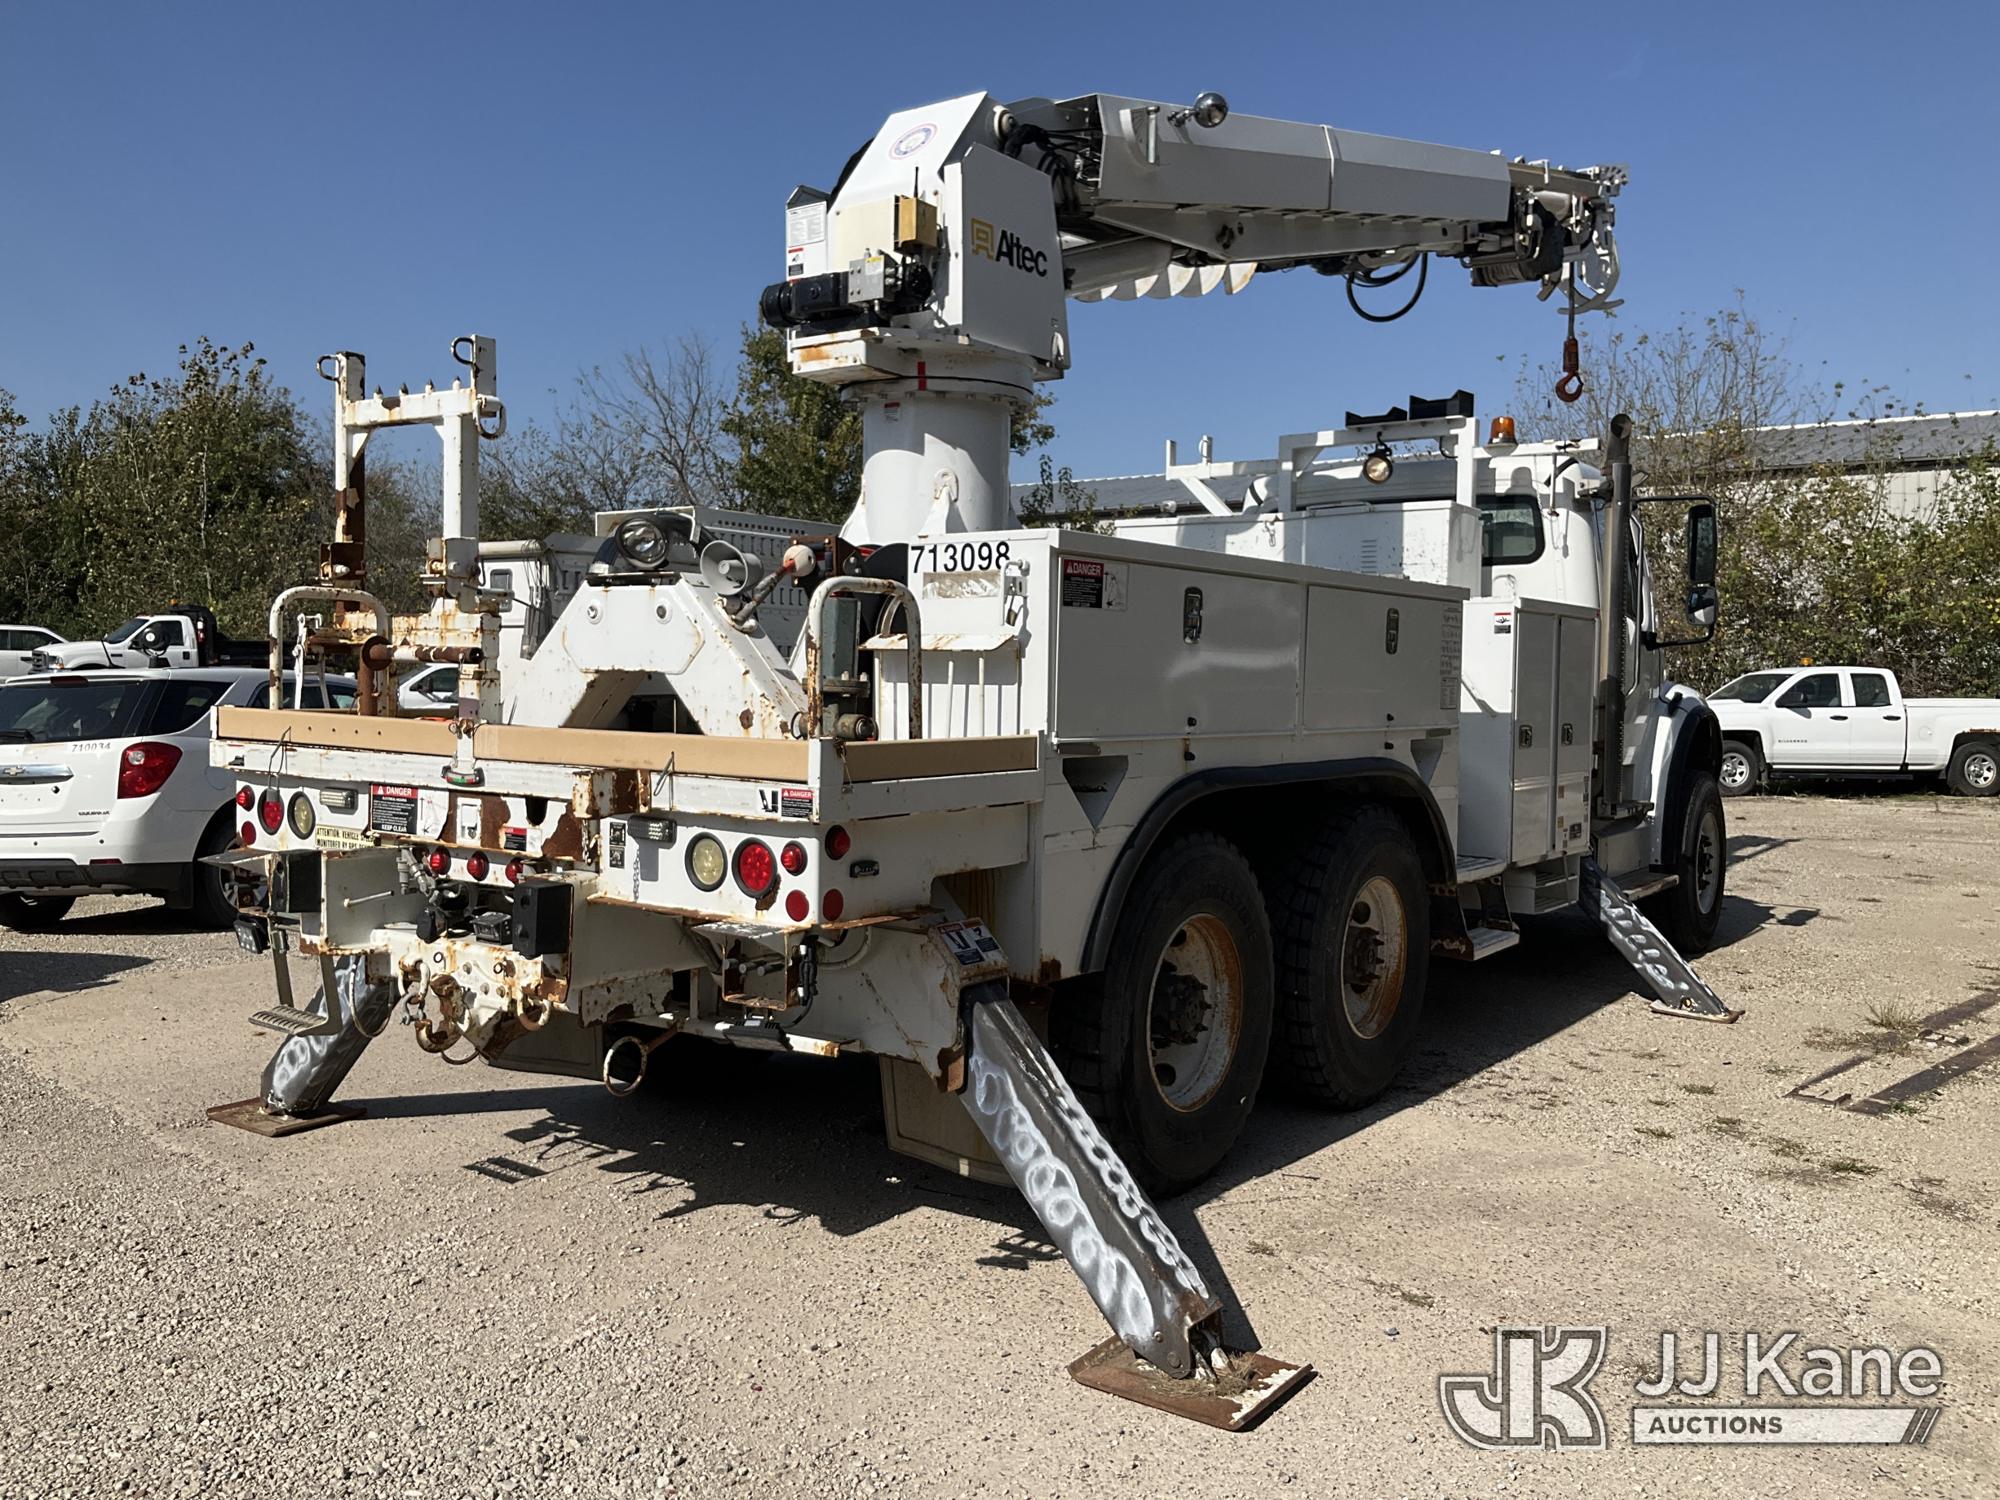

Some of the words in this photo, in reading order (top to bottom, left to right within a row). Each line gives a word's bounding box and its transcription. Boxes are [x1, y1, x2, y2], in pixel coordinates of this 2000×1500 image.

[995, 229, 1048, 277] Altec
[910, 540, 1010, 574] 713098
[1073, 562, 1102, 576] DANGER
[72, 742, 111, 753] 710034
[386, 786, 412, 797] DANGER
[342, 831, 359, 841] VEHICLE
